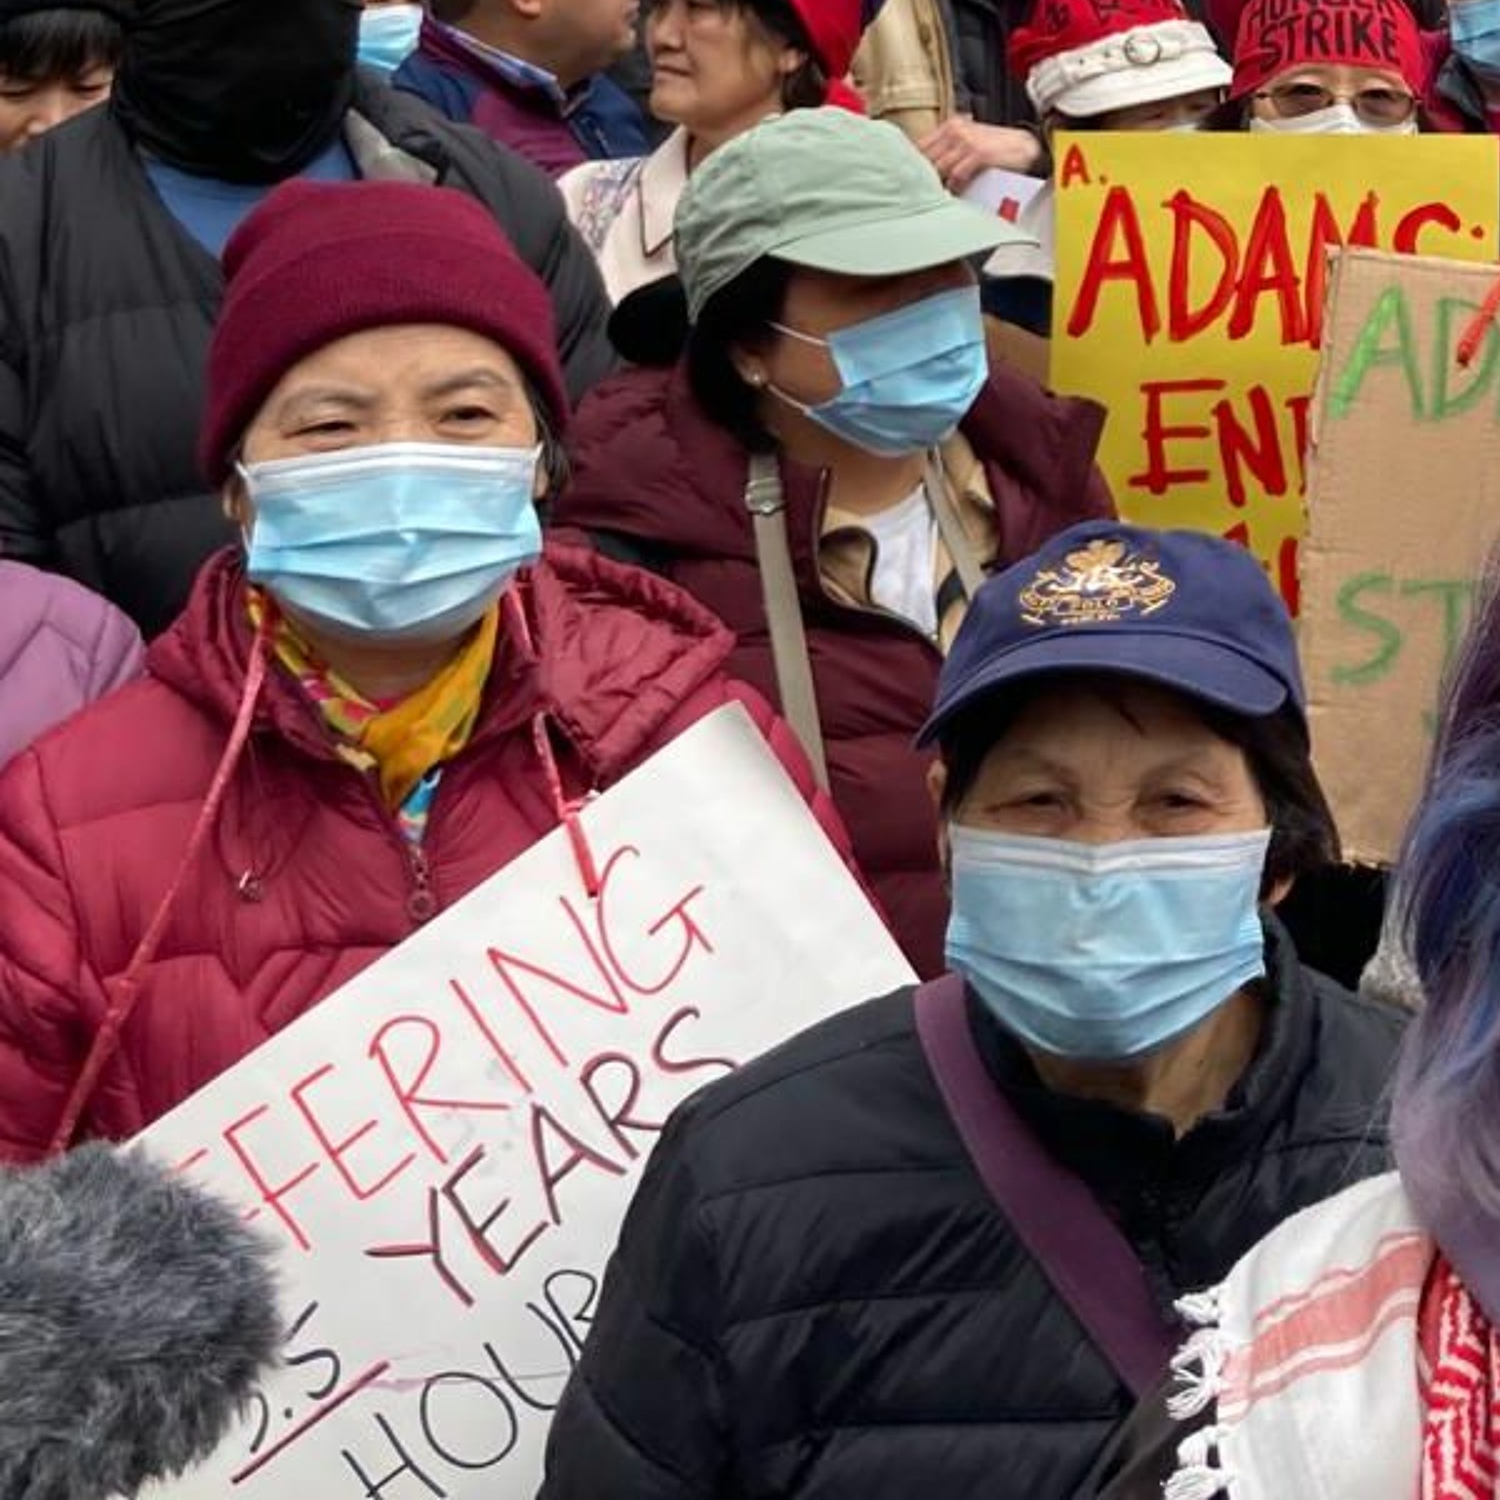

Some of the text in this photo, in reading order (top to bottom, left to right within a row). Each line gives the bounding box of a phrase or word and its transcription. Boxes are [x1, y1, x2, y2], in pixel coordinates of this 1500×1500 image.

[1259, 8, 1400, 74] STRIKE
[1060, 144, 1107, 188] A.
[165, 845, 714, 1251] FERING
[365, 1007, 744, 1307] YEARS
